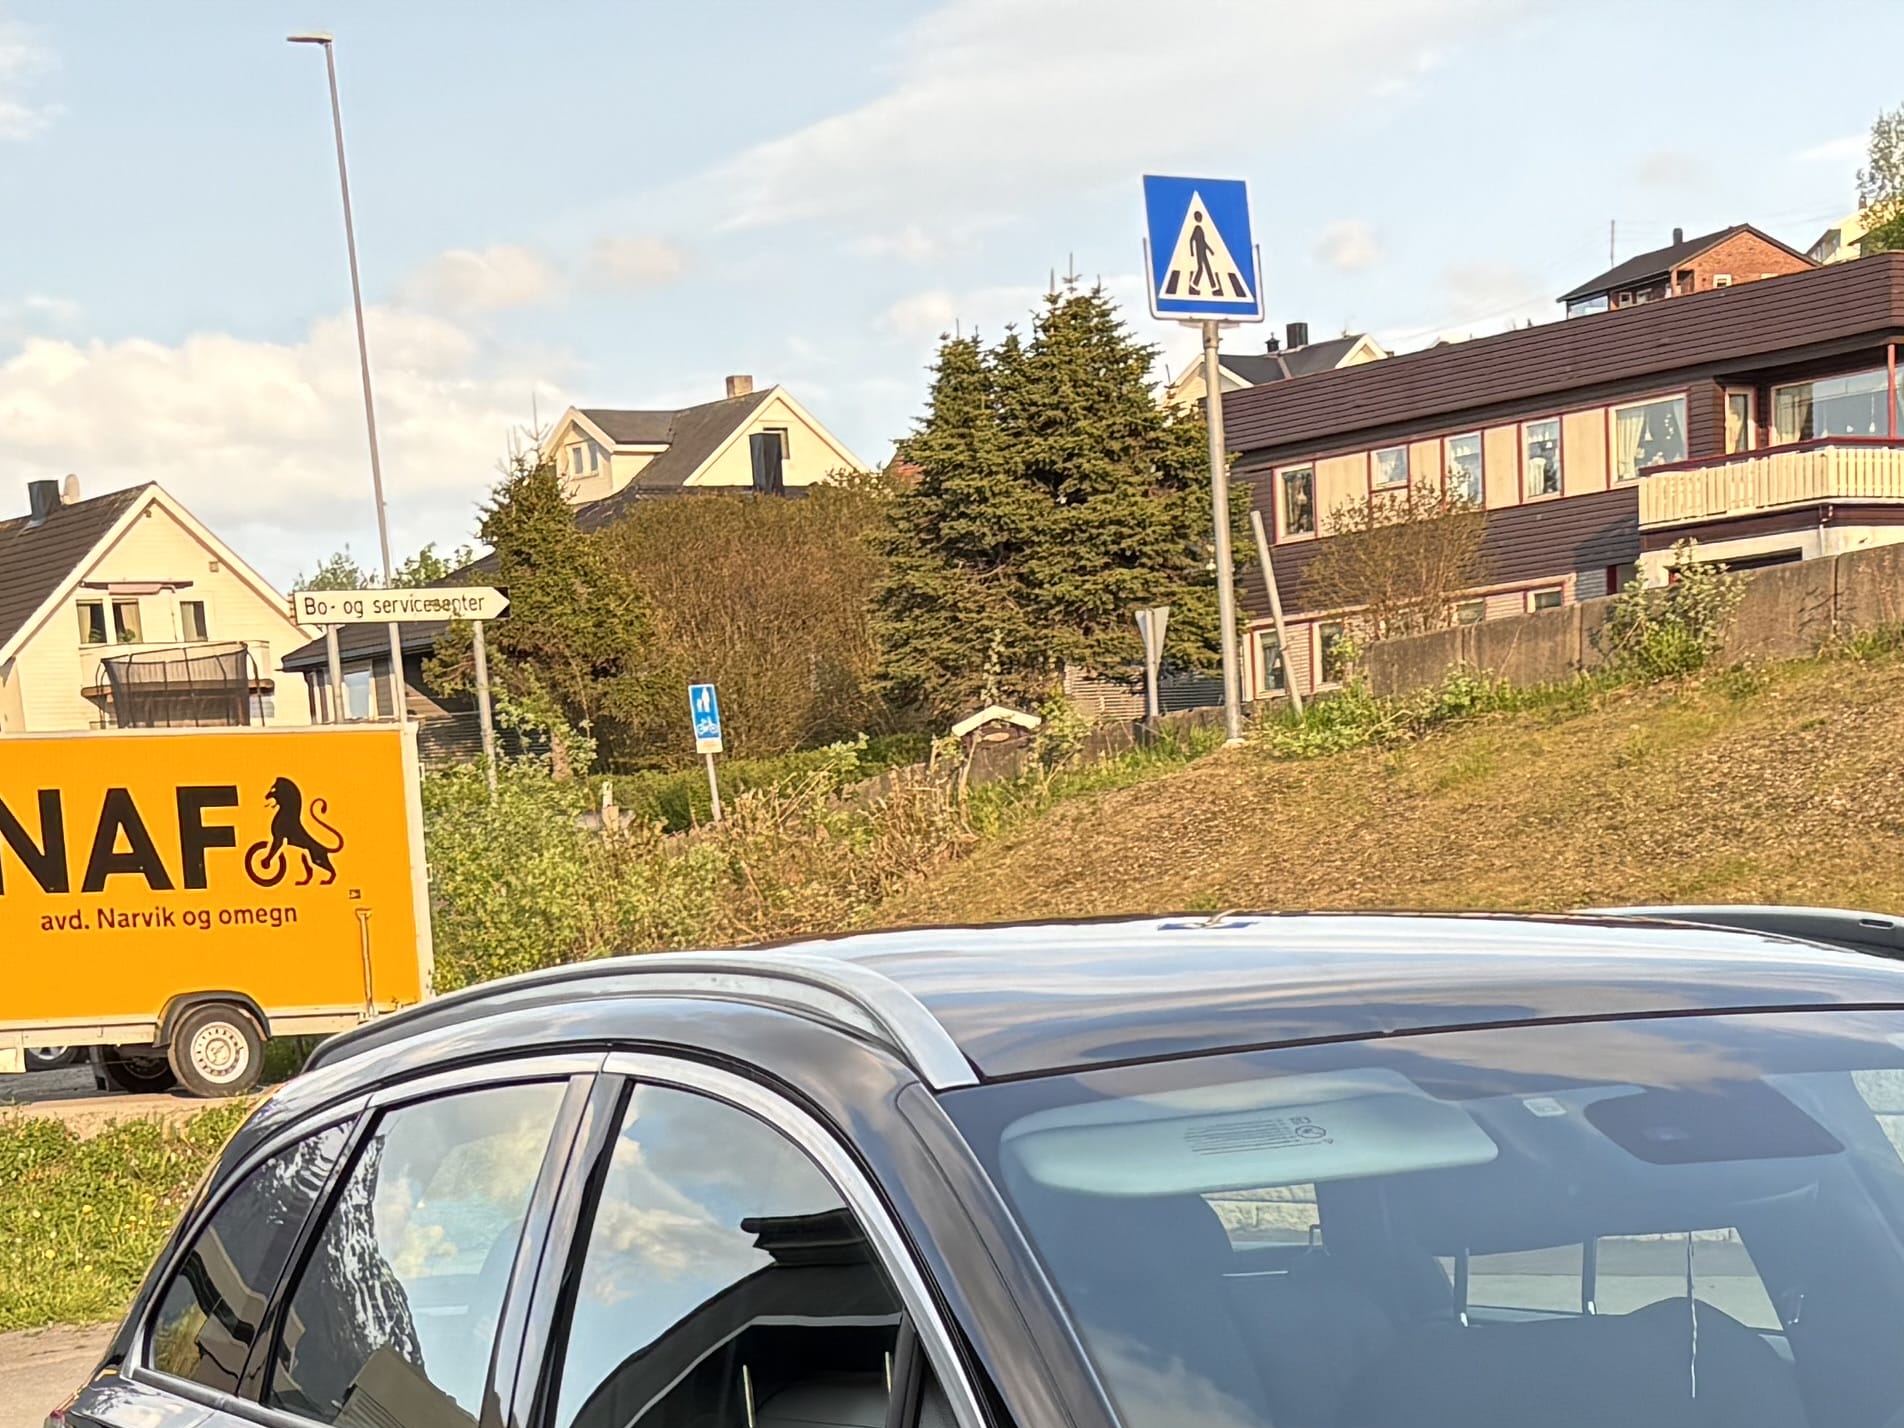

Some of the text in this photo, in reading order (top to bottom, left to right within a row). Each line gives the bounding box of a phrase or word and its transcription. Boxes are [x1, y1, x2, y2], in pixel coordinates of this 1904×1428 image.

[304, 597, 335, 615] Bo-
[343, 600, 364, 618] og
[41, 906, 298, 931] avd. Narvik og omegn
